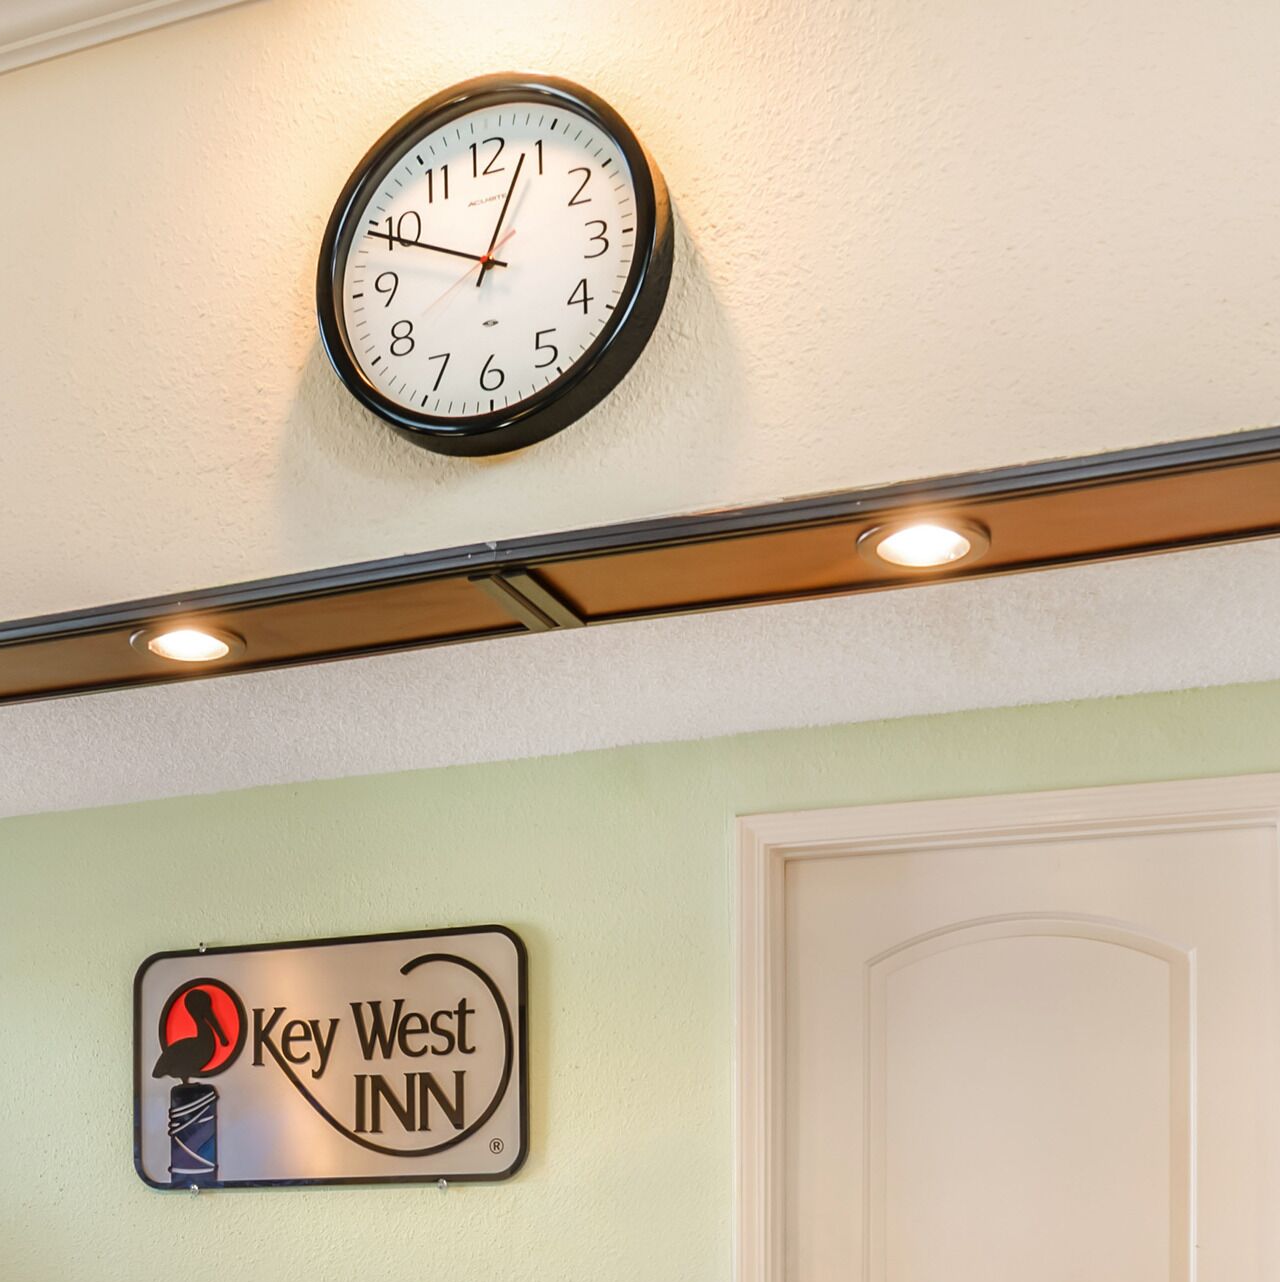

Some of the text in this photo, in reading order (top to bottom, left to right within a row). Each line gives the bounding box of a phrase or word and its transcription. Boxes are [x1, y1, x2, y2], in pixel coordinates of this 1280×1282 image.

[469, 137, 505, 178] 12
[534, 138, 544, 176] 1
[425, 164, 449, 203] 11
[567, 167, 593, 207] 2
[384, 210, 422, 251] 10
[583, 219, 610, 259] 3
[374, 271, 400, 308] 9
[567, 278, 595, 315] 4
[389, 319, 415, 357] 8
[534, 328, 559, 368] 5
[428, 352, 451, 392] 7
[479, 354, 505, 391] 6
[252, 998, 475, 1079] Key West
[353, 1070, 467, 1133] INN
